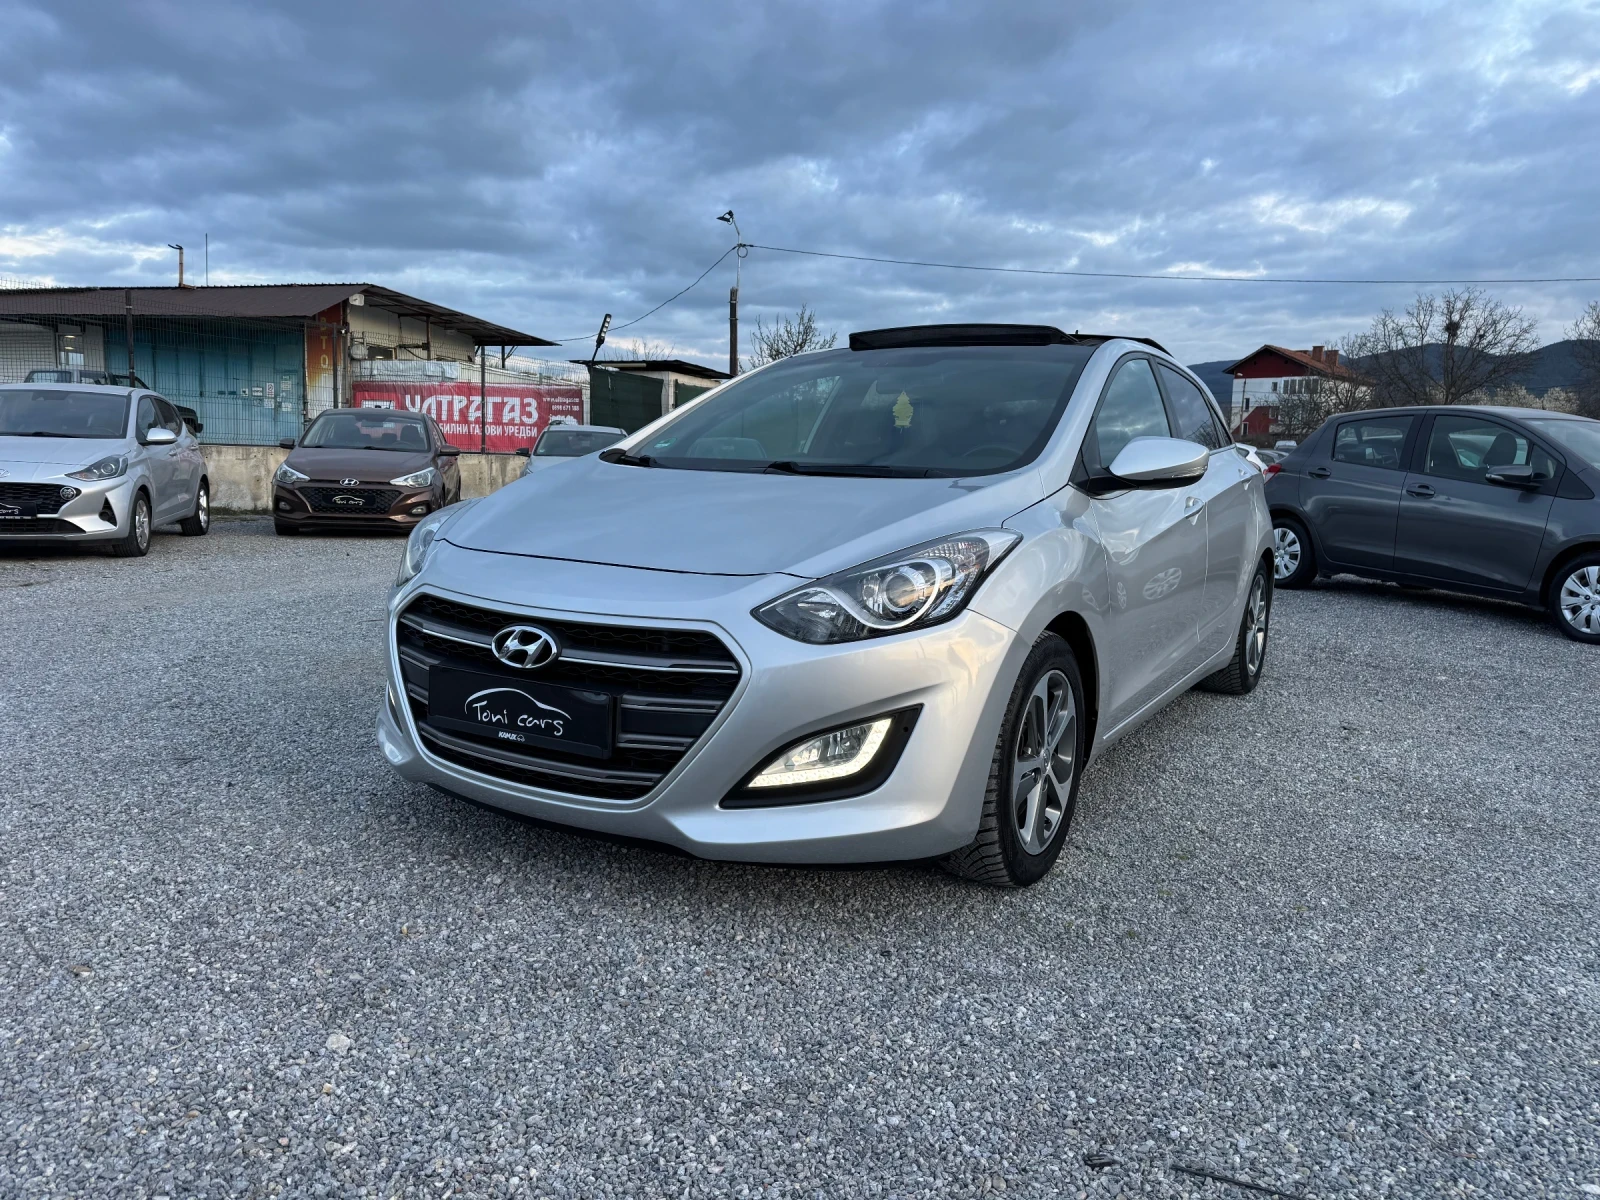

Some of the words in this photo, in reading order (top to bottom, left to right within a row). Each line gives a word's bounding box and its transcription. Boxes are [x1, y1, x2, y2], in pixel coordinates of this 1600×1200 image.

[405, 394, 539, 425] УЛТРАГАЗ
[470, 424, 502, 436] ГАОВИ
[504, 425, 537, 438] УРЕДБИ
[472, 700, 508, 725] Toni
[517, 713, 563, 736] cars
